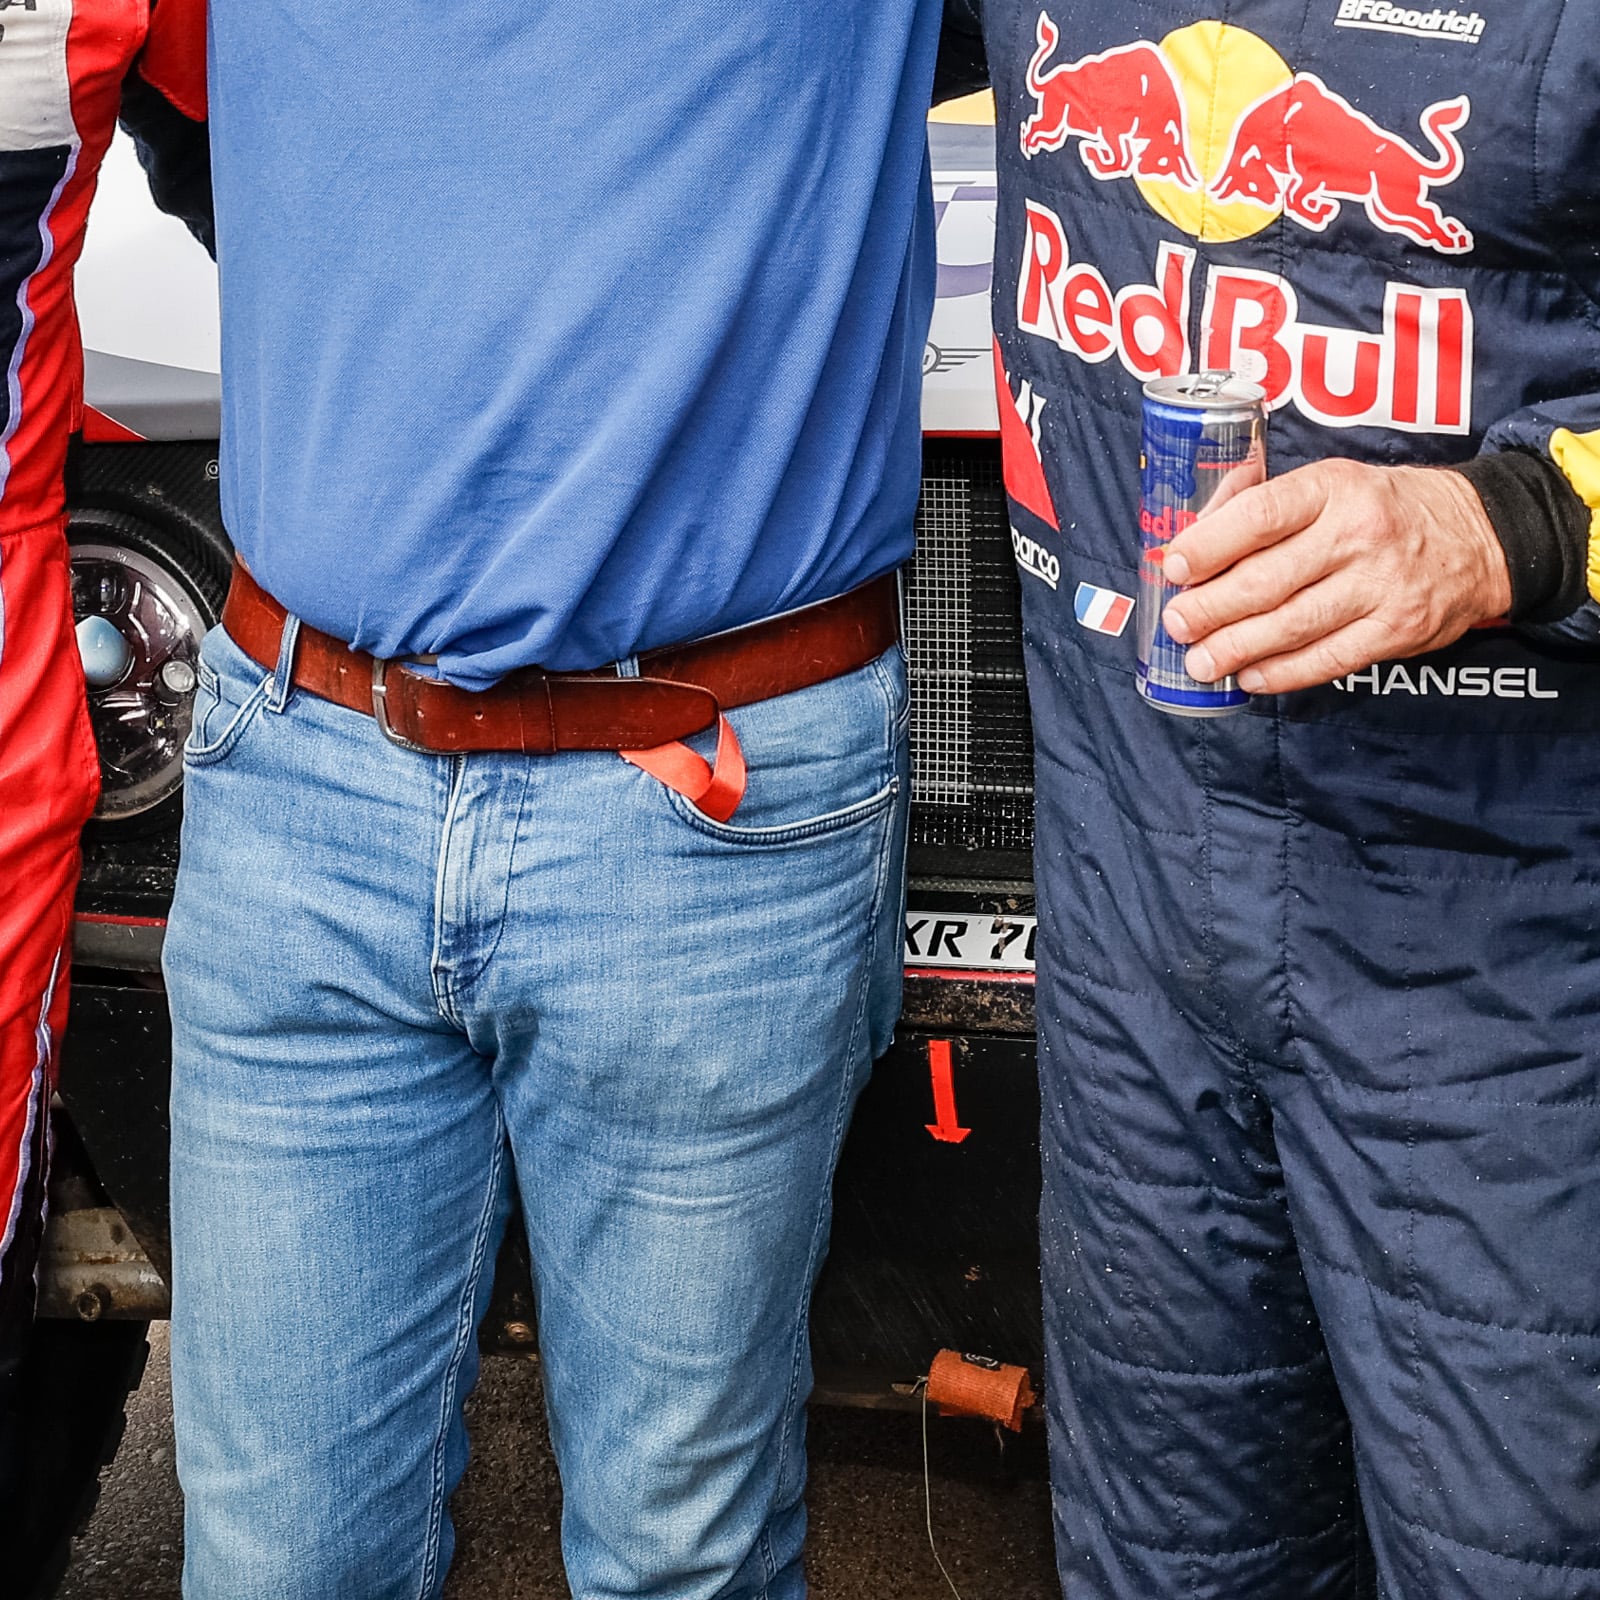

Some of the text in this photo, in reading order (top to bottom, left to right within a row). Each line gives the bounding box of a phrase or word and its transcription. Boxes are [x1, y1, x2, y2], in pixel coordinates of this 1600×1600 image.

[1018, 198, 1474, 436] Red Bull
[1332, 663, 1560, 699] HANSEL
